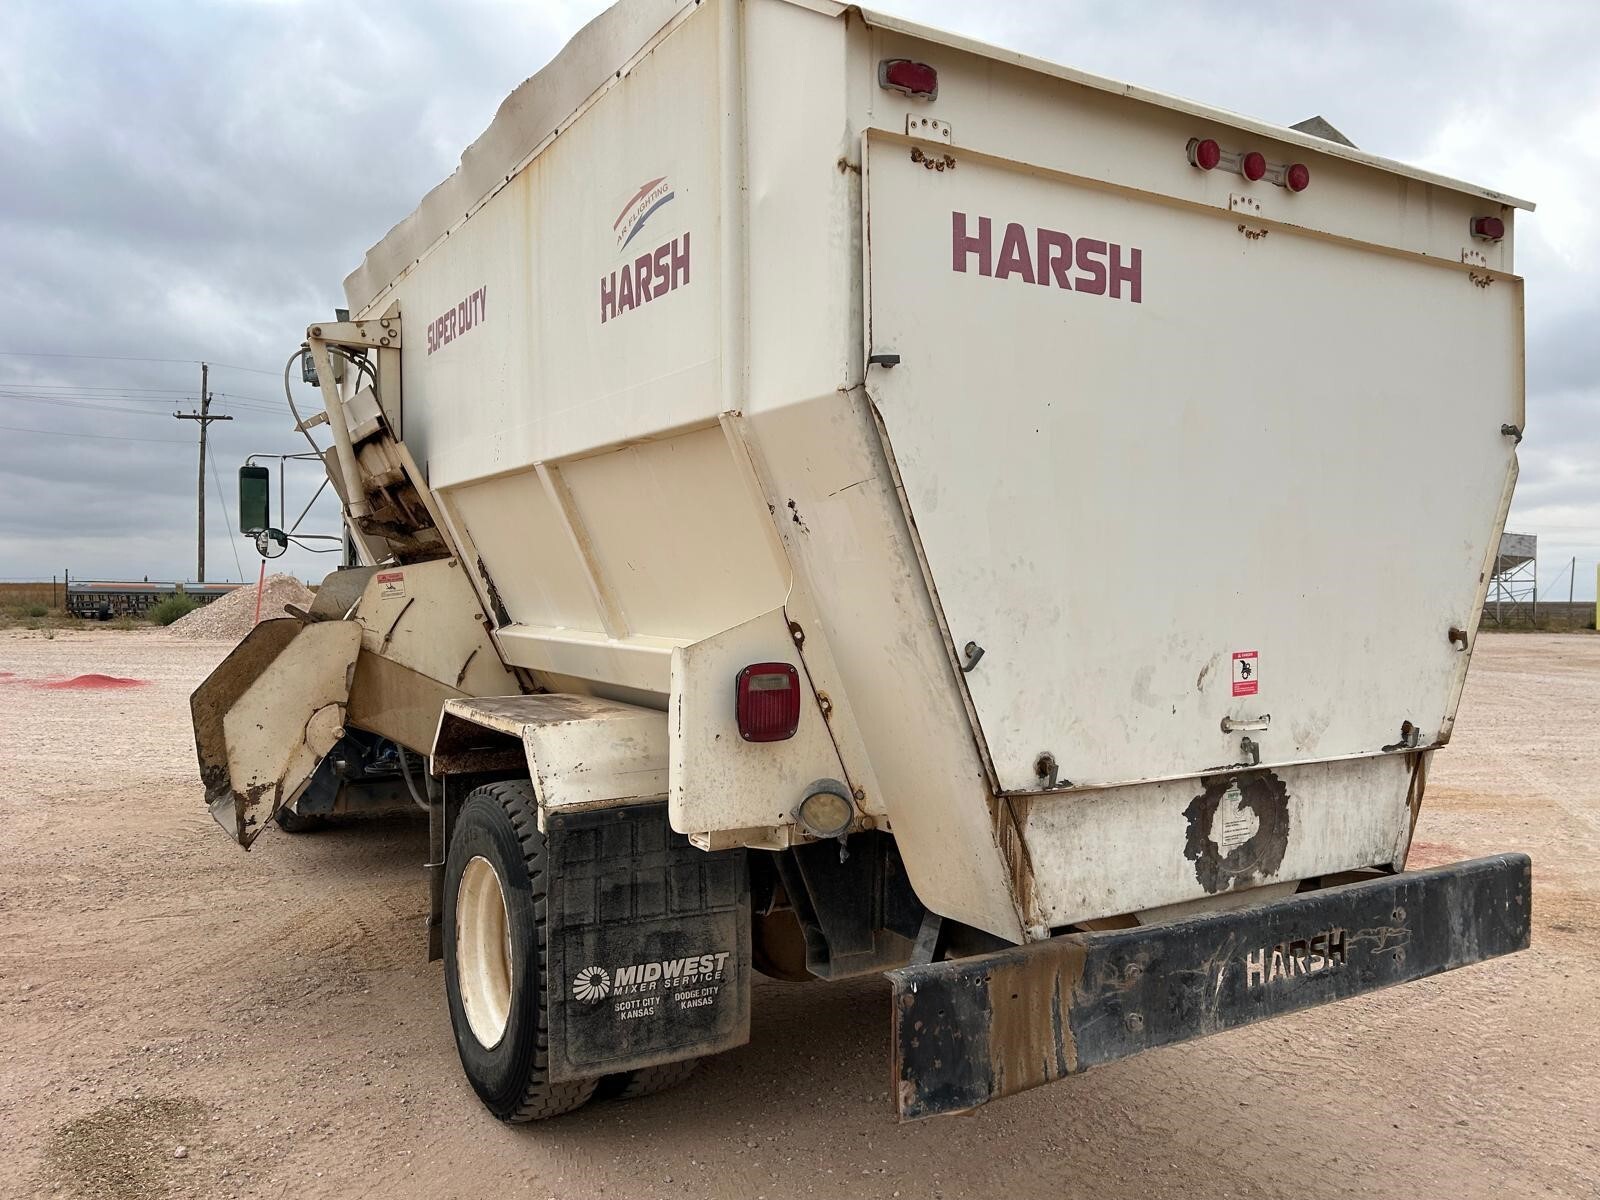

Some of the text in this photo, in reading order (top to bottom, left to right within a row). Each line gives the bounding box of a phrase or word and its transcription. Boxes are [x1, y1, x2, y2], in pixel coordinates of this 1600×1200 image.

[628, 183, 669, 227] FLIGHTING
[952, 211, 1142, 304] HARSH
[600, 231, 690, 324] HARSH
[427, 284, 487, 356] SUPER DUTY
[614, 951, 730, 987] MIDWEST
[1246, 928, 1346, 991] HARSH
[613, 970, 722, 996] MIXER SERVICE
[674, 985, 719, 1001] DODGE CITY
[614, 996, 661, 1012] SCOTT CITY
[620, 1007, 655, 1020] KANSAS
[680, 996, 713, 1010] KANSAS
